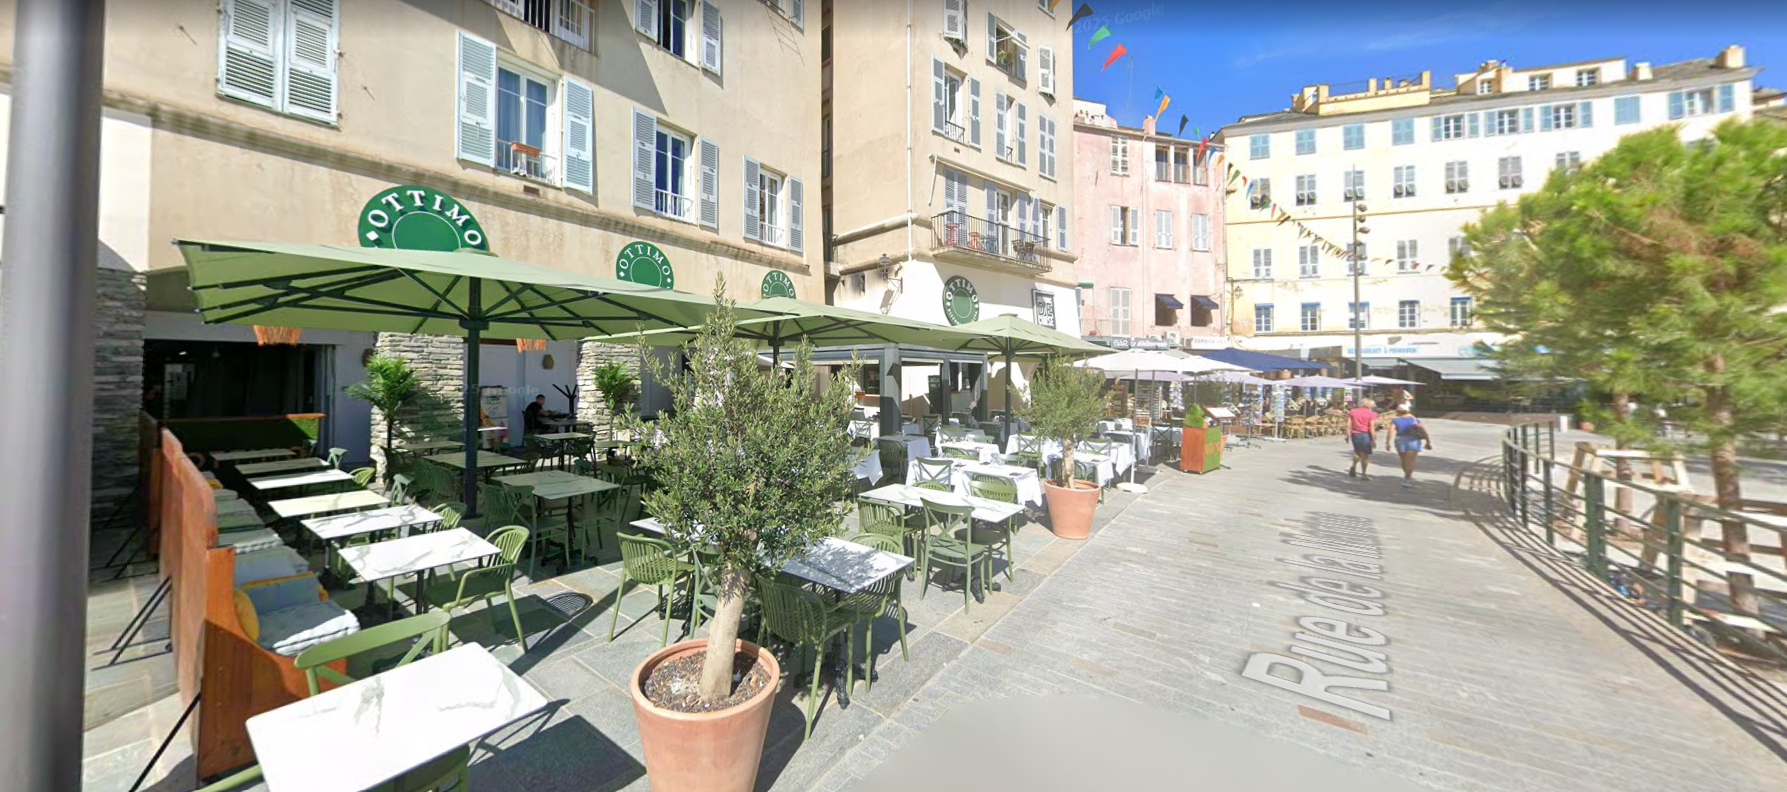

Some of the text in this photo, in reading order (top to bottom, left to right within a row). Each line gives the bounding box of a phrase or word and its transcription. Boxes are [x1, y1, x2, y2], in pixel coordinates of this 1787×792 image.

[367, 189, 482, 246] OTTIMO
[618, 243, 671, 276] OTTIMO
[762, 271, 795, 297] OTTIMO
[945, 279, 979, 303] OTTIMO
[1113, 339, 1129, 347] BAR
